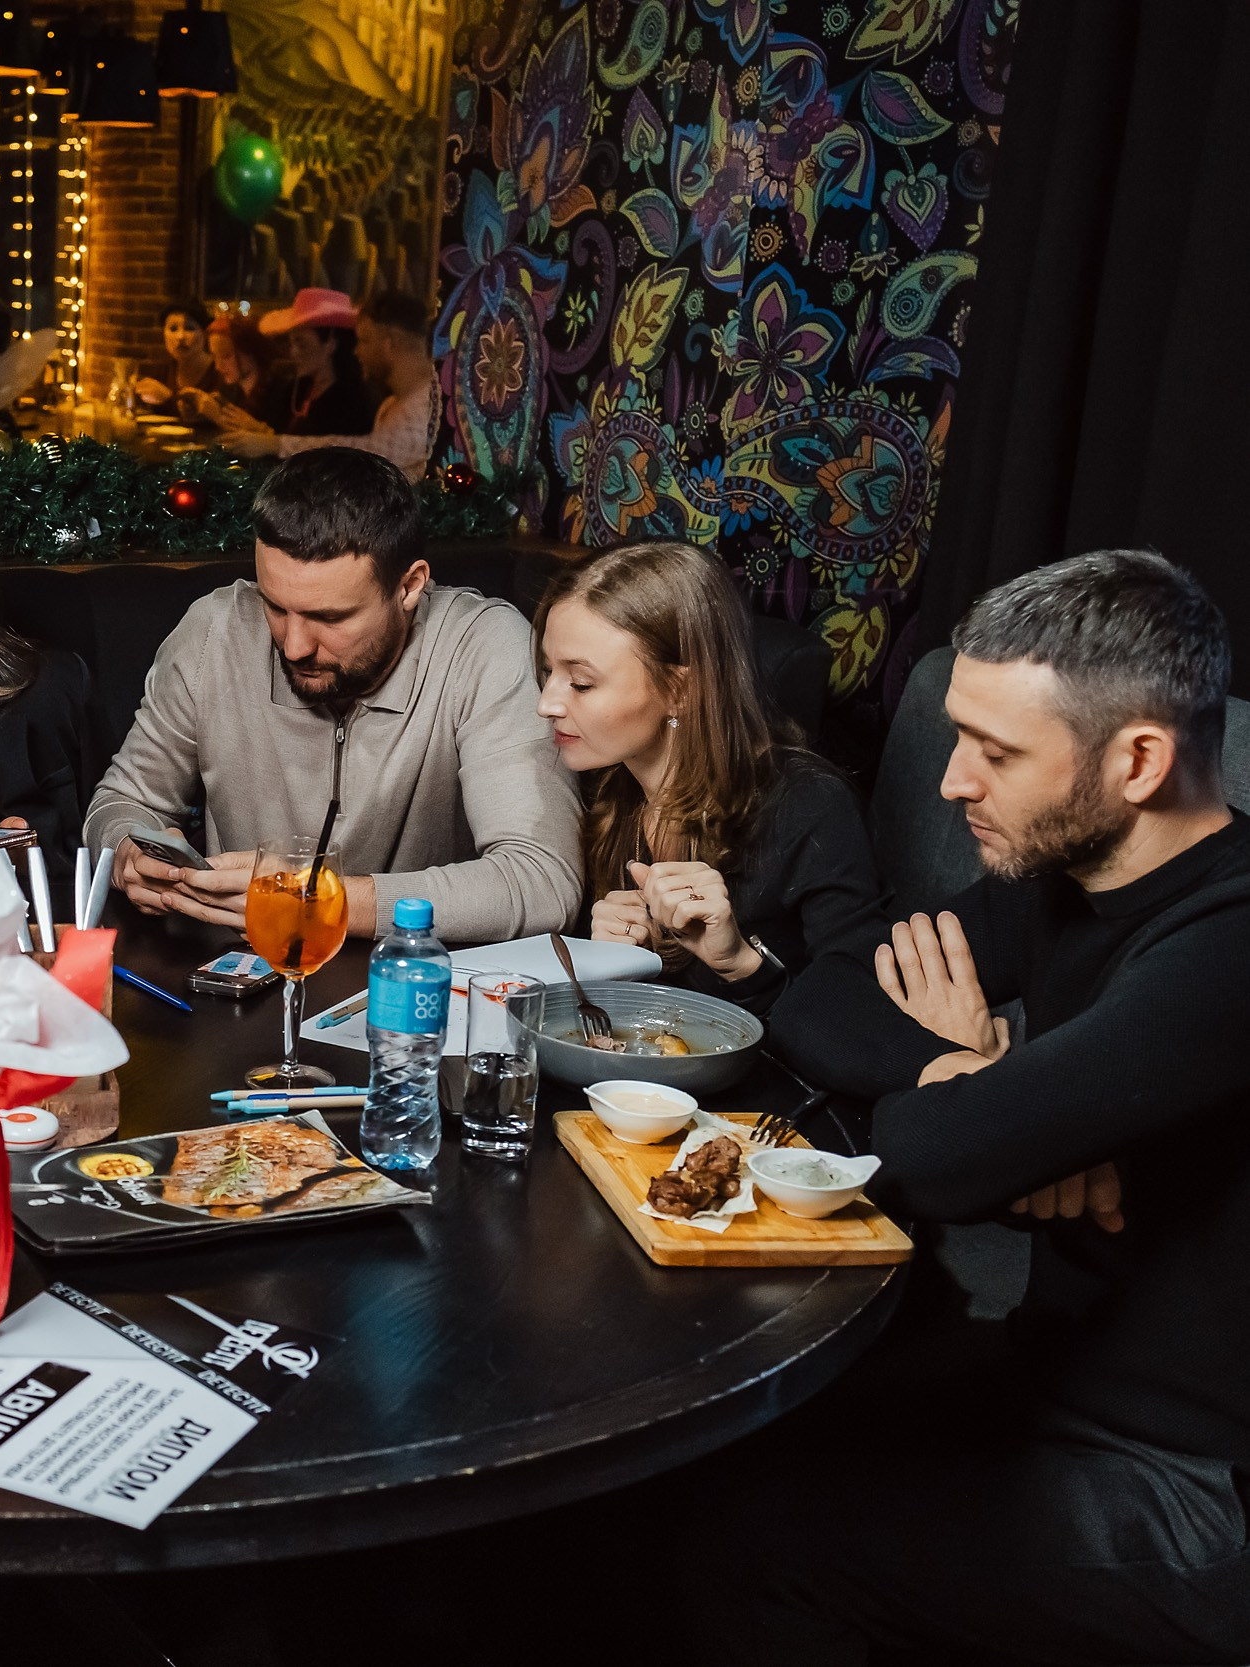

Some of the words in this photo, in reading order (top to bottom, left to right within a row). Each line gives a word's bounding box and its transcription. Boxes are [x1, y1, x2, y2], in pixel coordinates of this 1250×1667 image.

[121, 1324, 191, 1364] DETECTIT
[197, 1369, 272, 1415] DETECTIT
[105, 1417, 212, 1501] ДИПЛОМ
